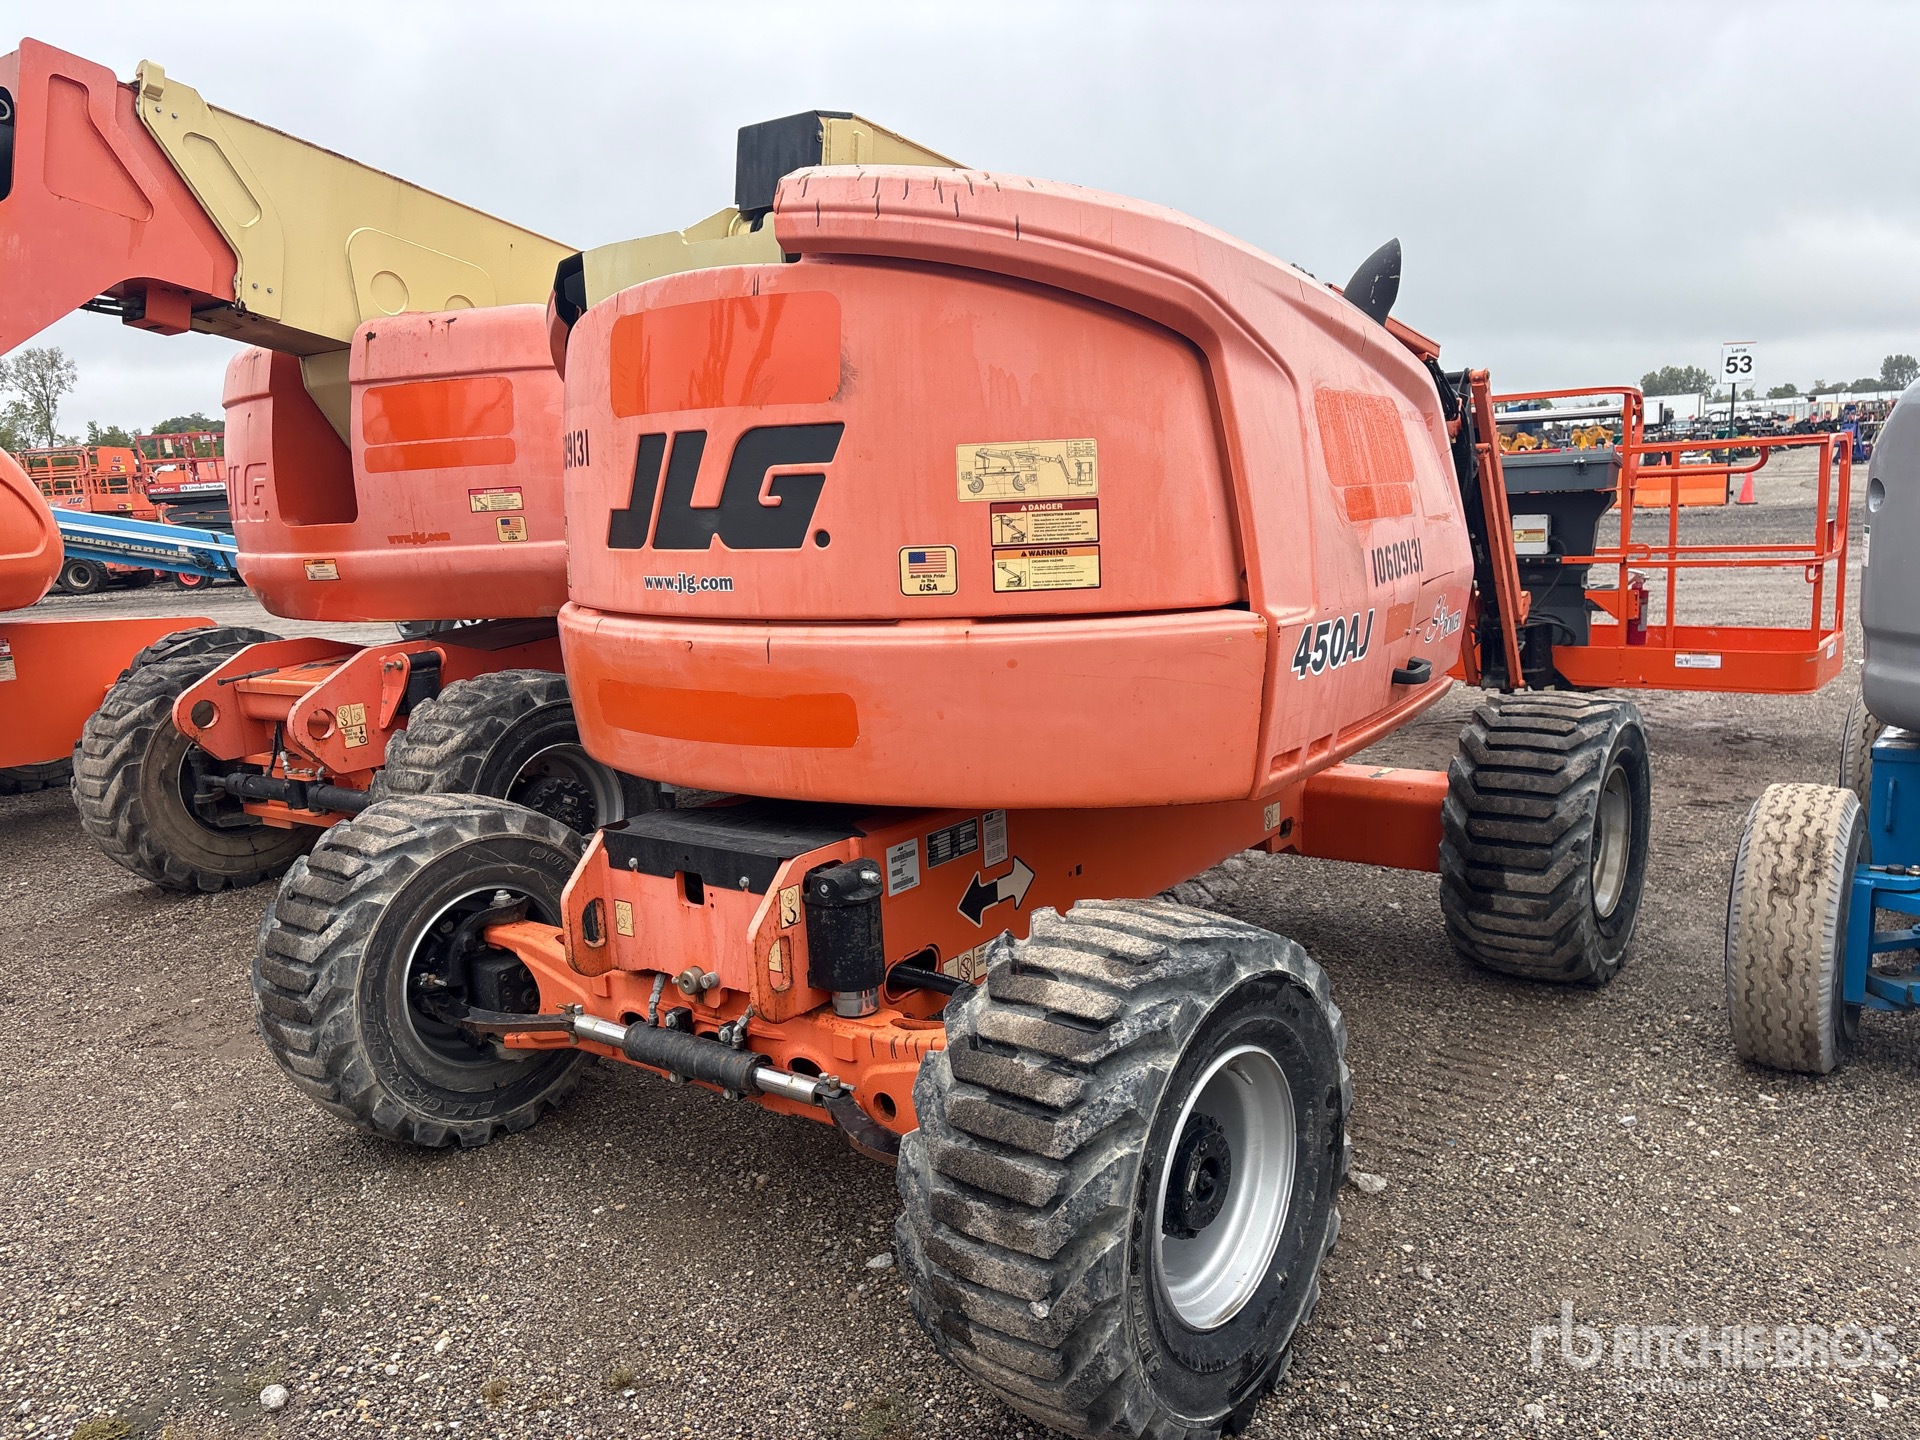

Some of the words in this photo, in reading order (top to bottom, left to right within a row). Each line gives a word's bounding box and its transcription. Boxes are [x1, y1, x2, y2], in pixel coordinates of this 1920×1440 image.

[1725, 355, 1753, 374] 53
[1028, 503, 1063, 511] DANGER
[1028, 549, 1068, 557] WARNING
[1371, 537, 1424, 587] 10609131
[643, 573, 734, 594] www.jlg.com
[919, 583, 938, 592] USA
[1291, 608, 1375, 680] 450AJ
